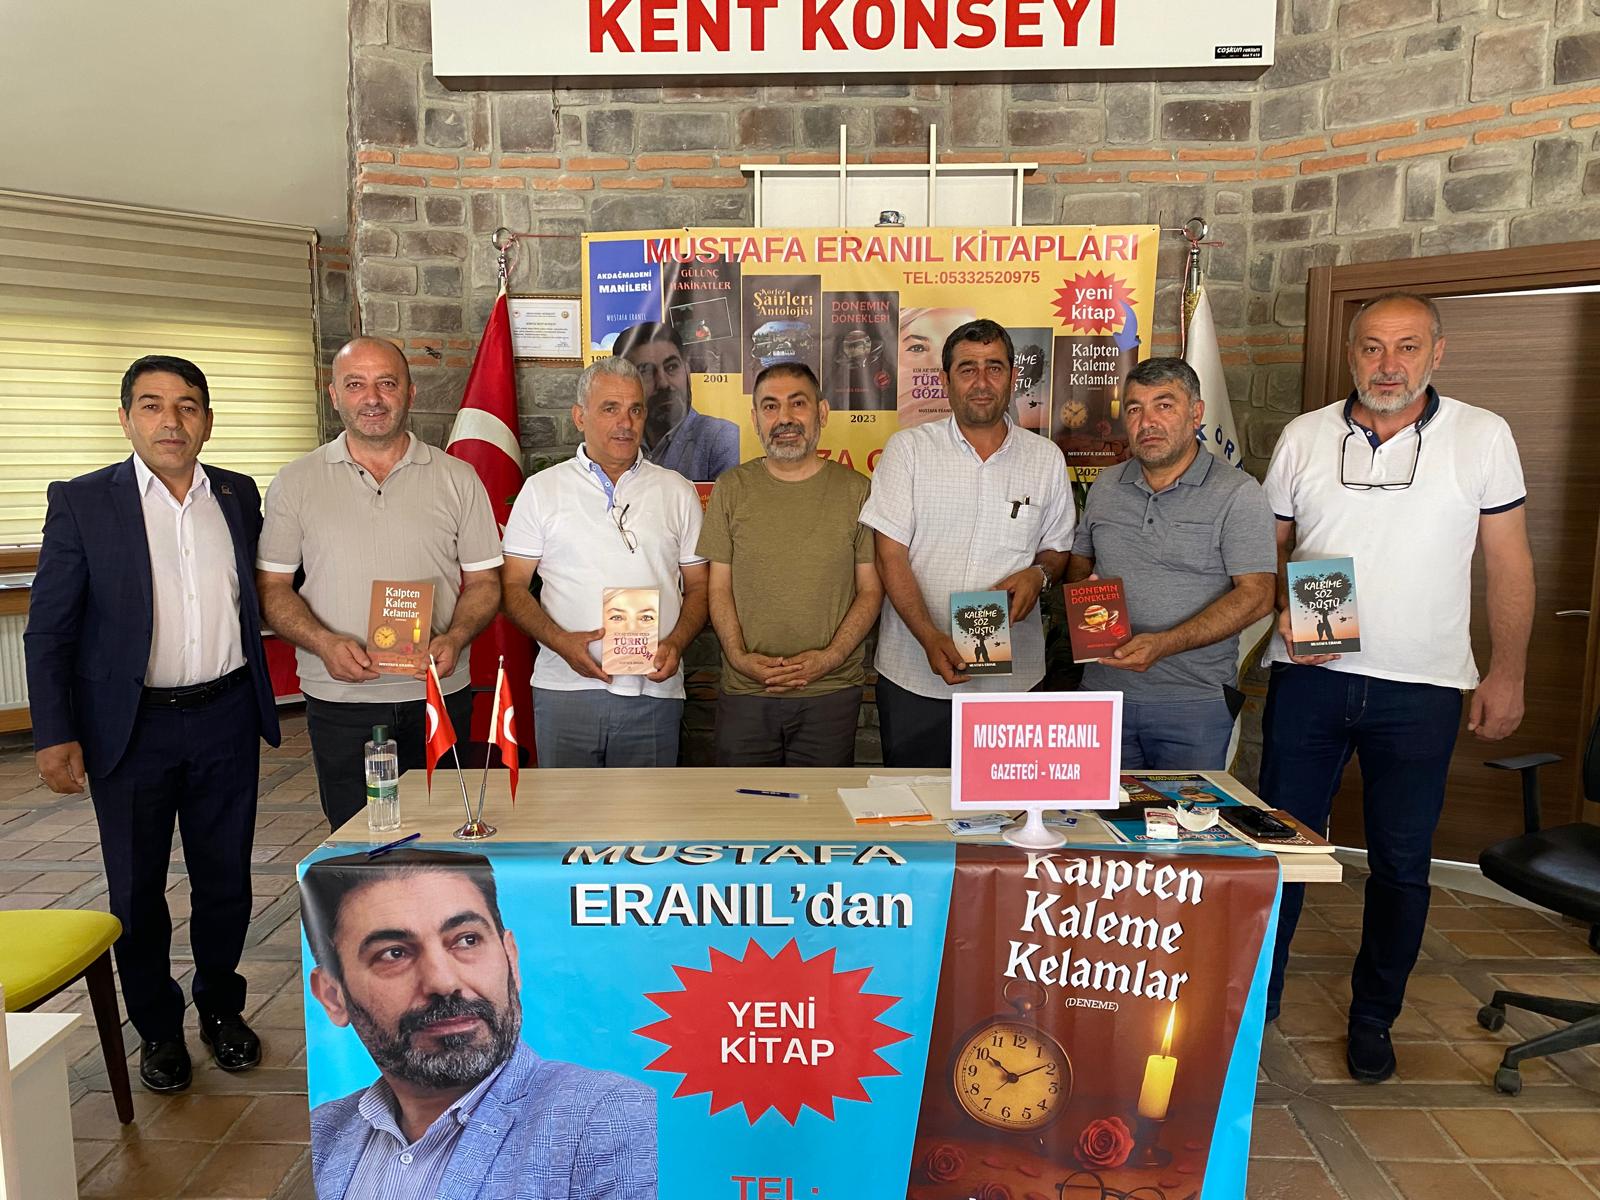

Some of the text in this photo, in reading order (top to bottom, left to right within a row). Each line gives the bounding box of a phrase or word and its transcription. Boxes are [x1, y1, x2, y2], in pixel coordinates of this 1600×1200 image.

[589, 0, 778, 53] KENT
[644, 230, 1138, 264] MUSTAFA ERANIL KİTAPLARI
[903, 270, 1040, 285] TEL:05332520975
[599, 280, 652, 293] MANİLERİ
[1075, 285, 1113, 304] yeni
[758, 306, 813, 318] Antolojisi
[1071, 305, 1115, 323] kitap
[1071, 344, 1119, 358] Kalpten
[1072, 359, 1116, 371] Kaleme
[703, 374, 729, 383] 2001
[912, 373, 943, 386] TÜR
[1070, 373, 1119, 385] Kelamlar
[851, 414, 877, 423] 2023
[385, 587, 420, 599] Kalpten
[385, 598, 417, 609] Kaleme
[383, 608, 420, 618] Kelamlar
[973, 724, 1100, 748] MUSTAFA ERANIL
[990, 760, 1038, 780] GAZETECİ
[1048, 763, 1081, 780] YAZAR
[561, 845, 907, 865] MUSTAFA
[1023, 852, 1204, 905] Kalpten
[570, 882, 914, 928] ERANIL’dan
[1019, 889, 1185, 954] Kaleme
[1003, 940, 1188, 1003] Kelamlar
[727, 996, 816, 1029] YENİ
[1065, 997, 1119, 1012] (DENEME)
[720, 1031, 835, 1066] KİTAP
